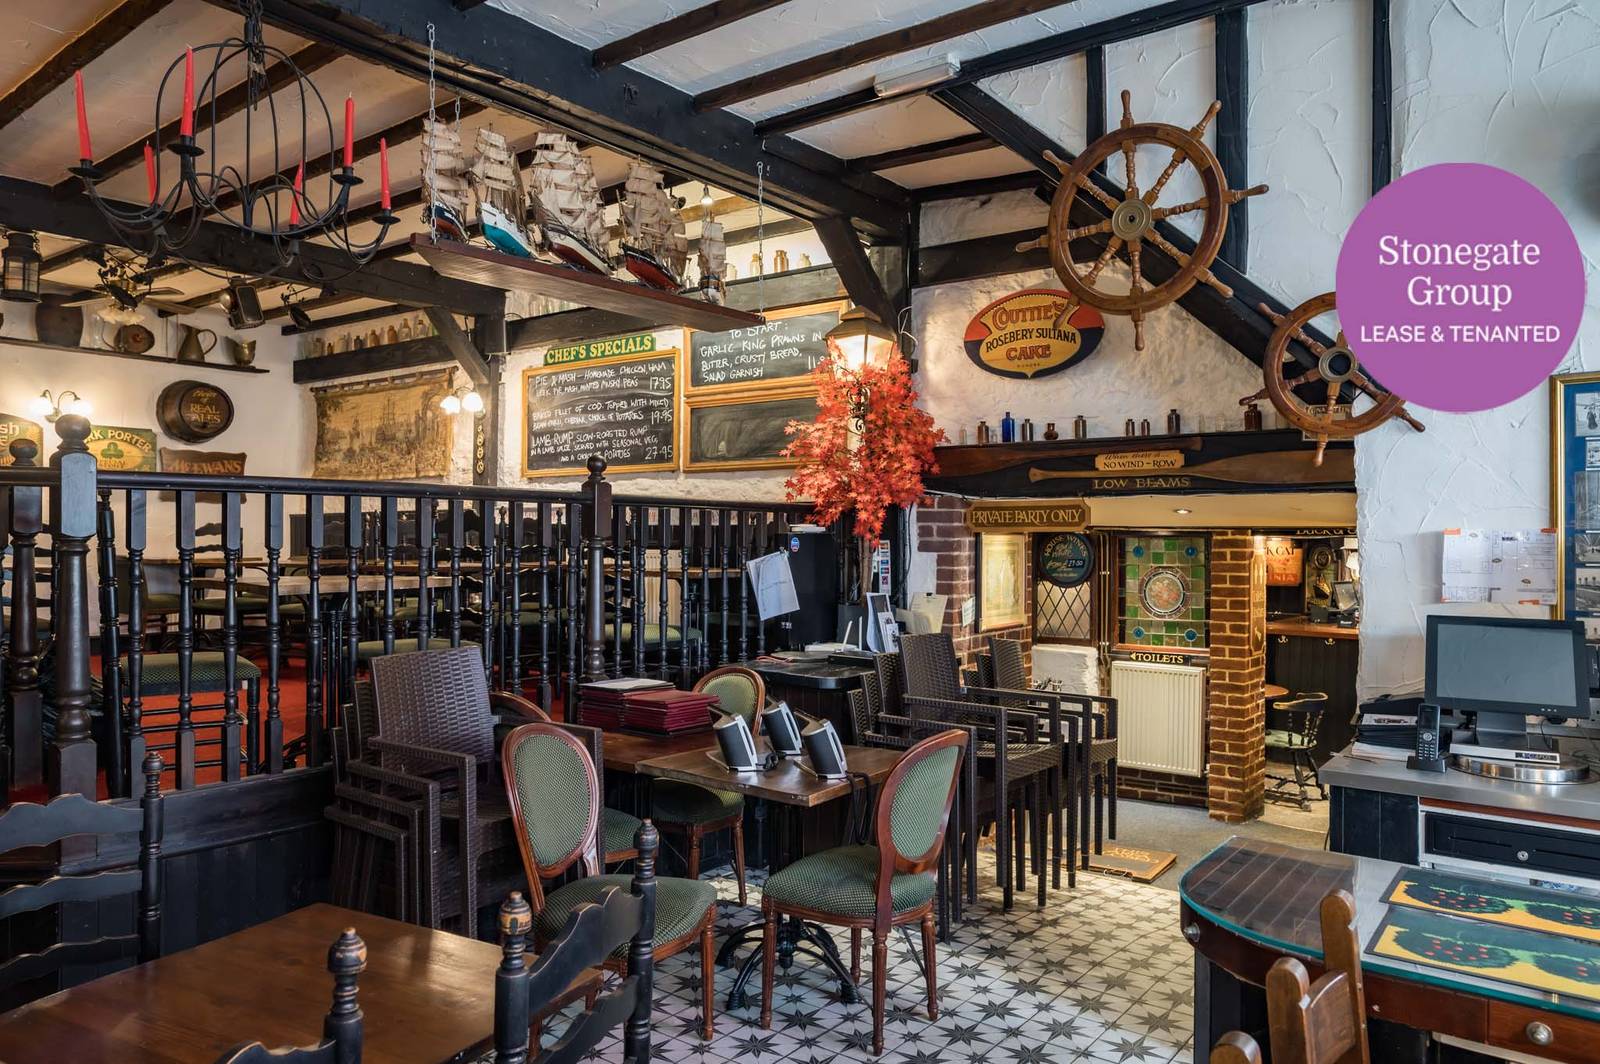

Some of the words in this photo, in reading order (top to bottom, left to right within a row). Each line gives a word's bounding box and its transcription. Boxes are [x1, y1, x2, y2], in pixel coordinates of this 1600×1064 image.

[729, 329, 742, 339] TO
[985, 327, 1034, 353] ROSEBERY
[1035, 327, 1077, 345] SULTANA
[546, 345, 587, 364] CHEF'S
[590, 335, 652, 360] SPECIALS
[700, 343, 734, 357] GARLIC
[742, 338, 767, 352] KING
[771, 333, 806, 348] PRAWNS
[812, 330, 822, 342] IN
[735, 351, 766, 365] CRUSTY
[1006, 344, 1052, 361] CAKE
[535, 375, 548, 388] PIE
[558, 372, 577, 384] MASH
[703, 370, 726, 383] SALAD
[729, 367, 764, 380] GARNISH
[190, 403, 220, 414] REAL
[630, 397, 647, 408] WITH
[107, 429, 152, 453] PORTER
[1103, 461, 1117, 469] NO
[1118, 460, 1145, 468] WIND
[1153, 459, 1177, 468] ROW
[1094, 479, 1129, 489] LOW
[1136, 477, 1191, 488] BEAMS
[972, 509, 1014, 527] PRIVATE
[1015, 509, 1050, 527] PARTY
[1051, 509, 1082, 523] ONLY
[1136, 652, 1184, 664] TOILETS
